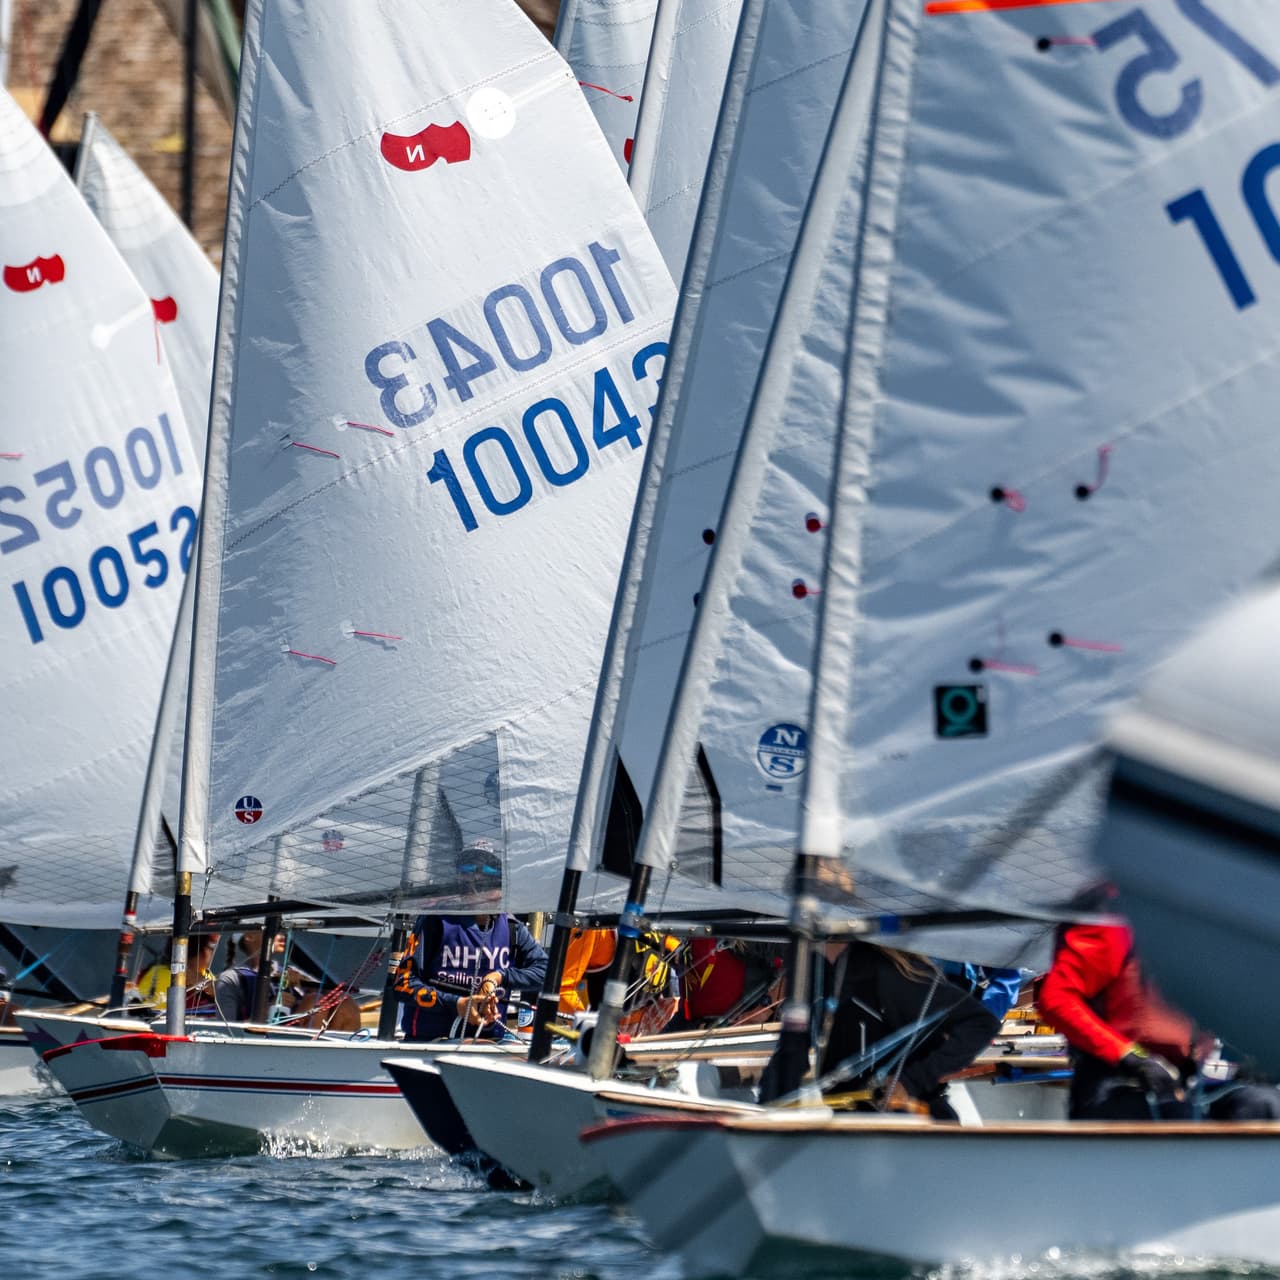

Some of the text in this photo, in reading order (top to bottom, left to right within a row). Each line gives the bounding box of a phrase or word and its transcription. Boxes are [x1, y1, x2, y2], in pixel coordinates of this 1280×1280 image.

[12, 505, 199, 644] 10052
[441, 945, 510, 969] NHYC
[437, 971, 483, 987] Sailing
